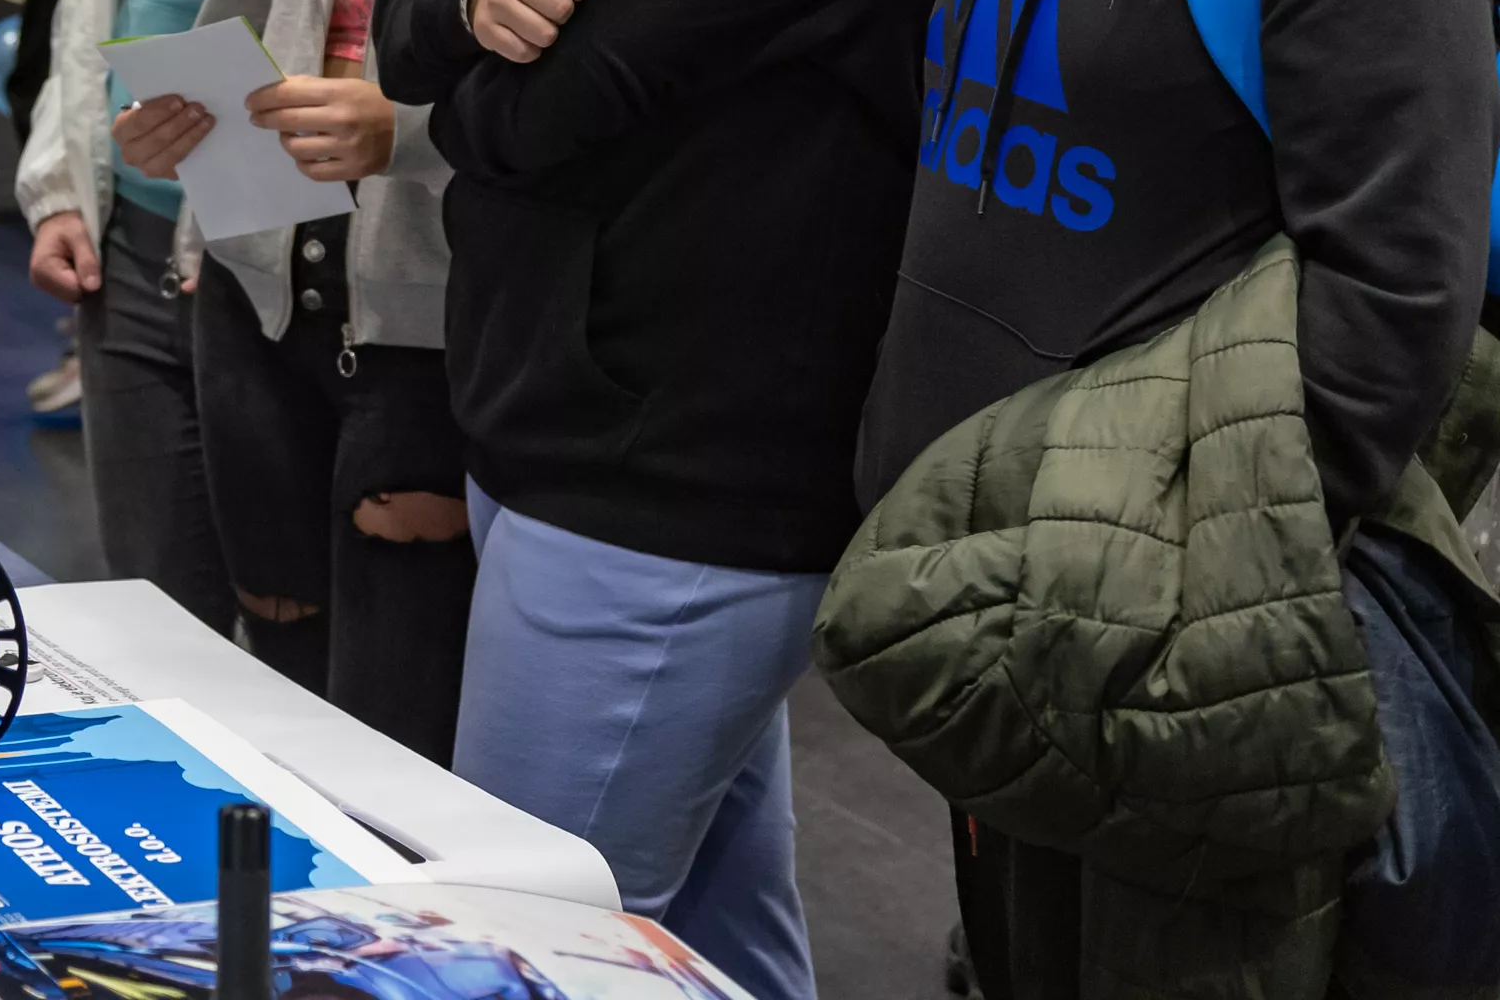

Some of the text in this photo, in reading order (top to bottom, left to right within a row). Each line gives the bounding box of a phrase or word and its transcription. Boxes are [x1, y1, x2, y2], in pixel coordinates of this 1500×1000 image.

[919, 66, 1116, 232] didas
[2, 779, 176, 909] LEKTROSISTEMI
[124, 822, 182, 863] d.o.o.
